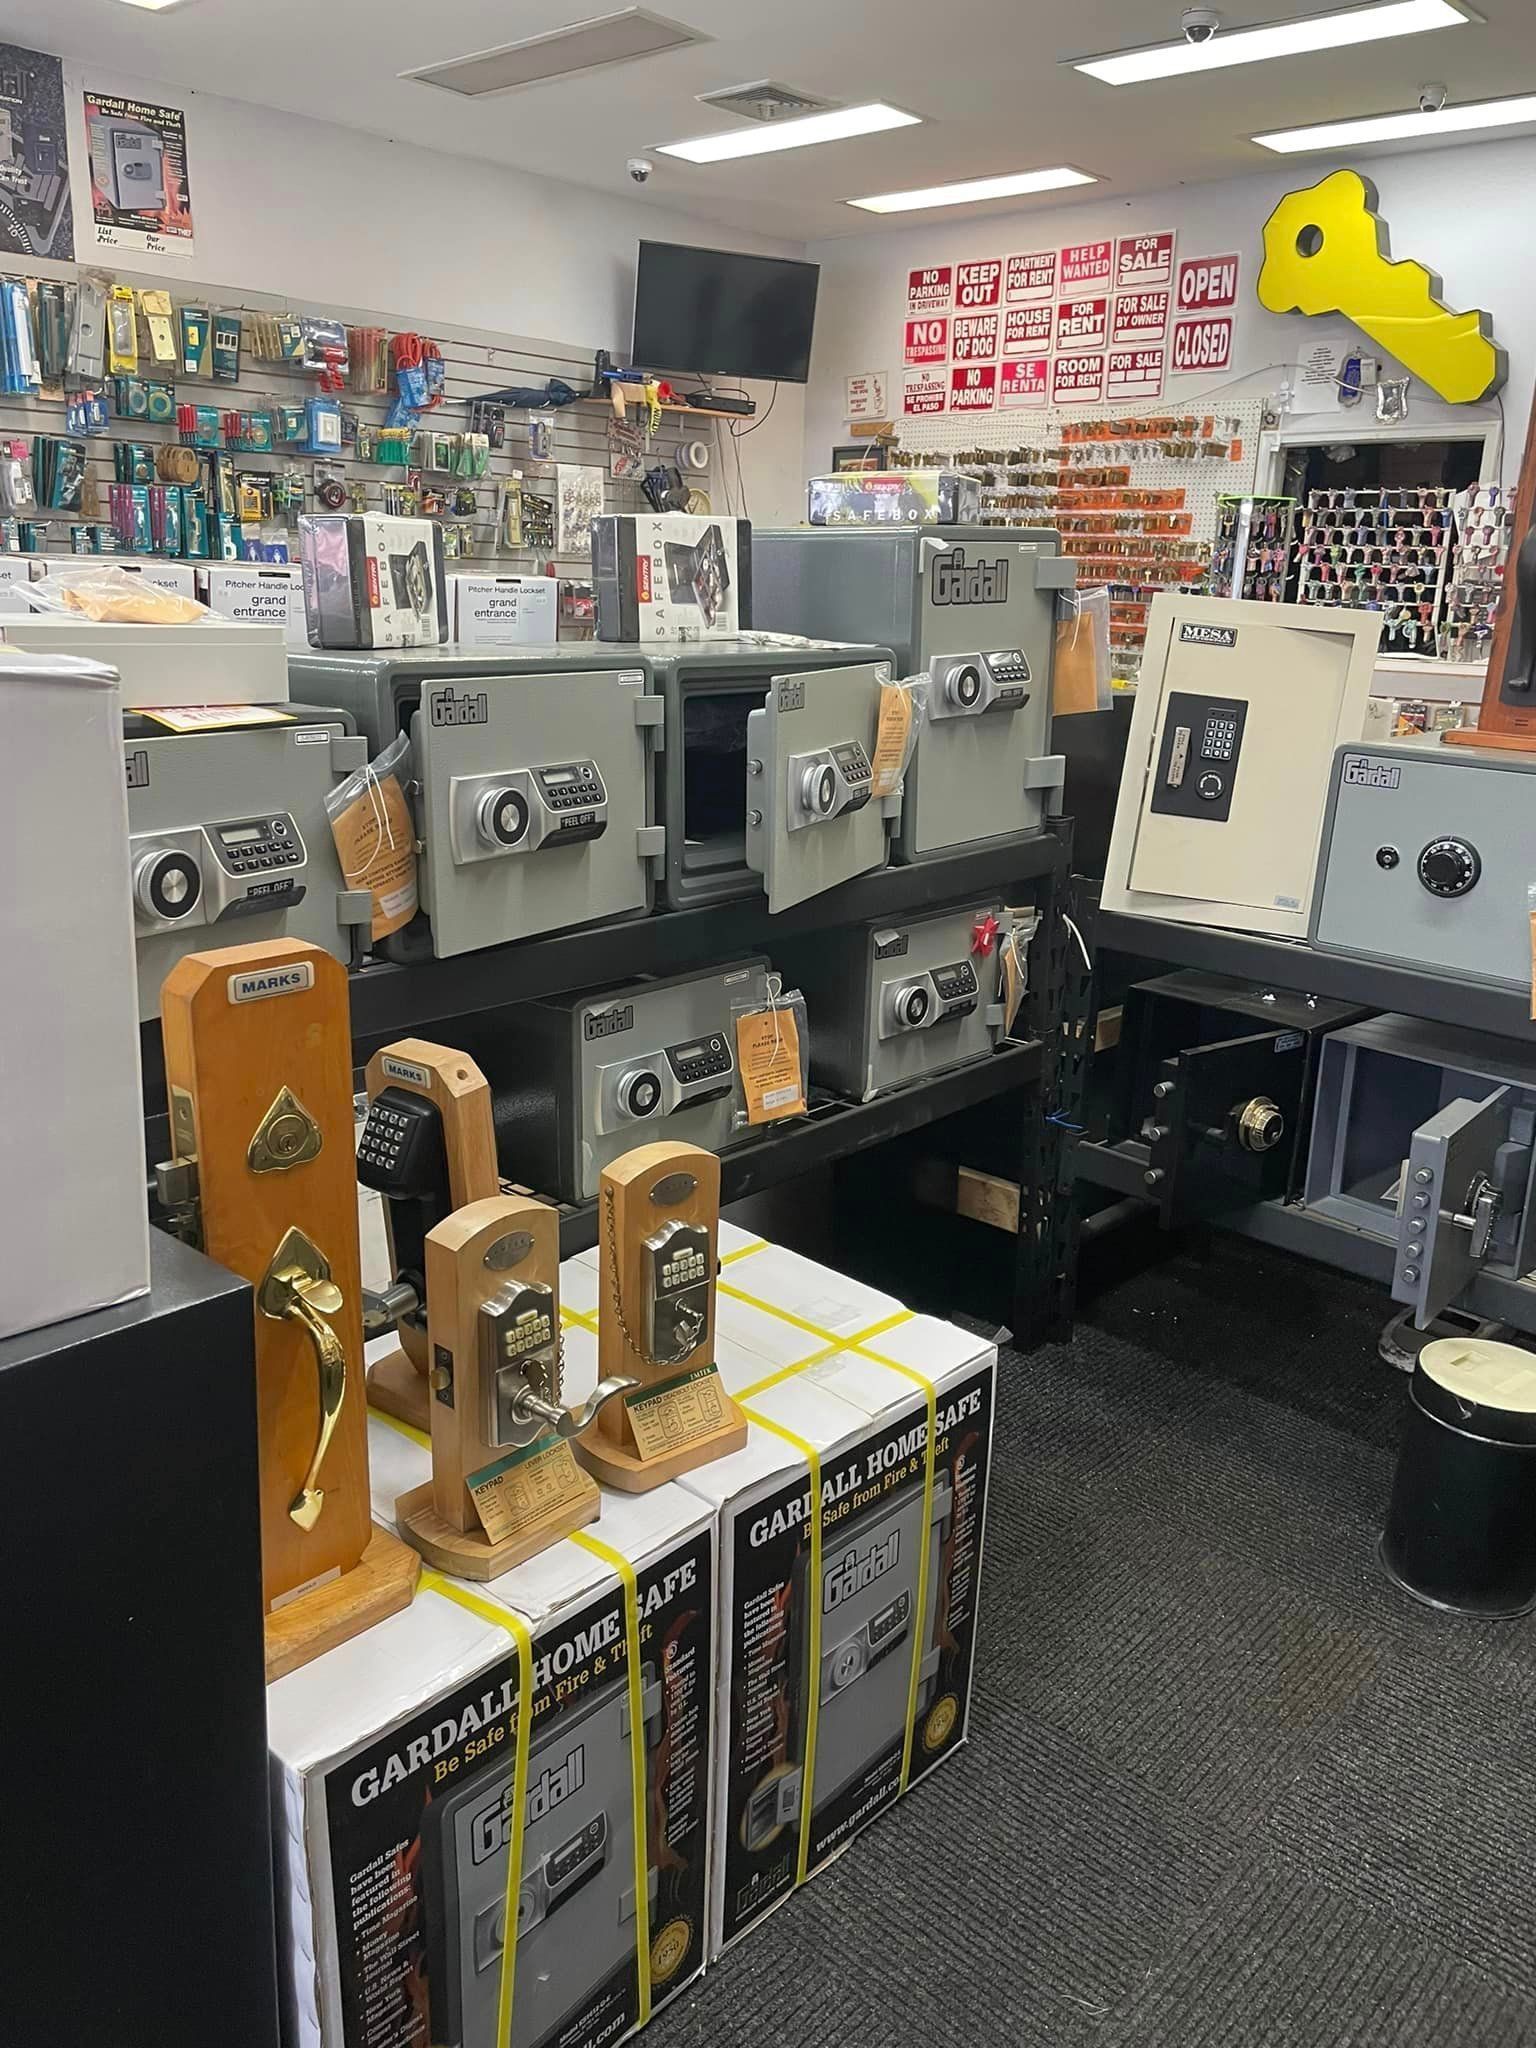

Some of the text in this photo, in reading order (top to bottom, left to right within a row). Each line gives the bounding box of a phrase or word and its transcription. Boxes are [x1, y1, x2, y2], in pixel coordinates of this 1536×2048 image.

[86, 94, 181, 121] Gardall Home Safe
[165, 120, 181, 128] Theft
[97, 227, 112, 236] List
[97, 235, 118, 245] Price
[146, 234, 160, 242] Our
[146, 243, 166, 252] Price
[1069, 245, 1105, 263] HELP
[1134, 238, 1158, 251] FOR
[1009, 254, 1055, 272] APARTMENT
[1063, 260, 1110, 280] WANTED
[1119, 249, 1170, 272] SALE
[922, 270, 939, 284] NO
[958, 264, 999, 286] KEEP
[1008, 268, 1054, 289] FOR RENT
[1181, 264, 1236, 304] OPEN
[909, 284, 950, 300] PARKING
[961, 284, 994, 305] OUT
[909, 299, 949, 310] IN DRIVEWAY
[1071, 302, 1095, 317] FOR
[1117, 293, 1167, 314] FOR SALE
[1008, 308, 1051, 327] HOUSE
[1058, 313, 1105, 336] RENT
[1116, 312, 1164, 328] BY OWNER
[913, 322, 943, 345] NO
[954, 316, 998, 339] BEWARE
[1006, 324, 1050, 340] FOR RENT
[906, 343, 947, 358] TRESPASSING
[956, 336, 993, 358] OF DOG
[1175, 323, 1229, 366] CLOSED
[1057, 357, 1101, 373] ROOM
[1110, 350, 1161, 368] FOR SALE
[921, 373, 930, 381] NO
[967, 369, 981, 387] NO
[1015, 362, 1036, 377] SE
[1055, 370, 1102, 387] FOR RENT
[905, 381, 946, 394] TRESPASSING
[1001, 376, 1046, 393] RENTA
[906, 396, 916, 404] SE
[951, 388, 994, 406] PARKING
[912, 402, 939, 412] EL PASO
[642, 557, 651, 593] SENTRY
[932, 547, 1009, 606] Gardall
[225, 580, 256, 589] Pitcher
[258, 581, 289, 590] Handle
[468, 585, 493, 593] Pitcher
[251, 595, 286, 607] grand
[489, 598, 517, 609] grand
[233, 607, 286, 617] entrance
[474, 609, 517, 618] entrance
[1182, 625, 1234, 642] MESA
[430, 687, 488, 727] Gardall
[1343, 758, 1400, 789] Gardall
[241, 972, 301, 994] MARKS
[584, 1004, 634, 1041] Gardall
[388, 1064, 423, 1082] MARKS
[633, 1396, 663, 1414] KEYPAD
[866, 1420, 928, 1481] HOME
[935, 1387, 982, 1436] SAFE
[542, 1442, 568, 1460] LOCKSET
[474, 1475, 504, 1496] KEYPAD
[823, 1502, 850, 1529] Safe
[852, 1482, 882, 1510] from
[883, 1466, 907, 1491] Fire
[908, 1457, 919, 1474] &
[920, 1436, 950, 1466] Teft
[823, 1528, 901, 1615] Gardall
[665, 1645, 696, 1674] Standard
[351, 1677, 520, 1807] GARDALL
[531, 1608, 621, 1691] HOME
[432, 1623, 653, 1785] Be Safe fm Fire & Tft
[349, 1838, 410, 1884] Gardall Safes
[350, 1860, 397, 1897] have been
[351, 1868, 402, 1907] featured in
[352, 1871, 413, 1918] the following
[353, 1884, 412, 1932] publications:
[360, 1894, 419, 1938] Time Magazine
[362, 1930, 389, 1952] Money
[362, 1931, 401, 1962] Magazine
[362, 1929, 420, 1974] The Wall Street
[363, 1957, 394, 1984] Journal
